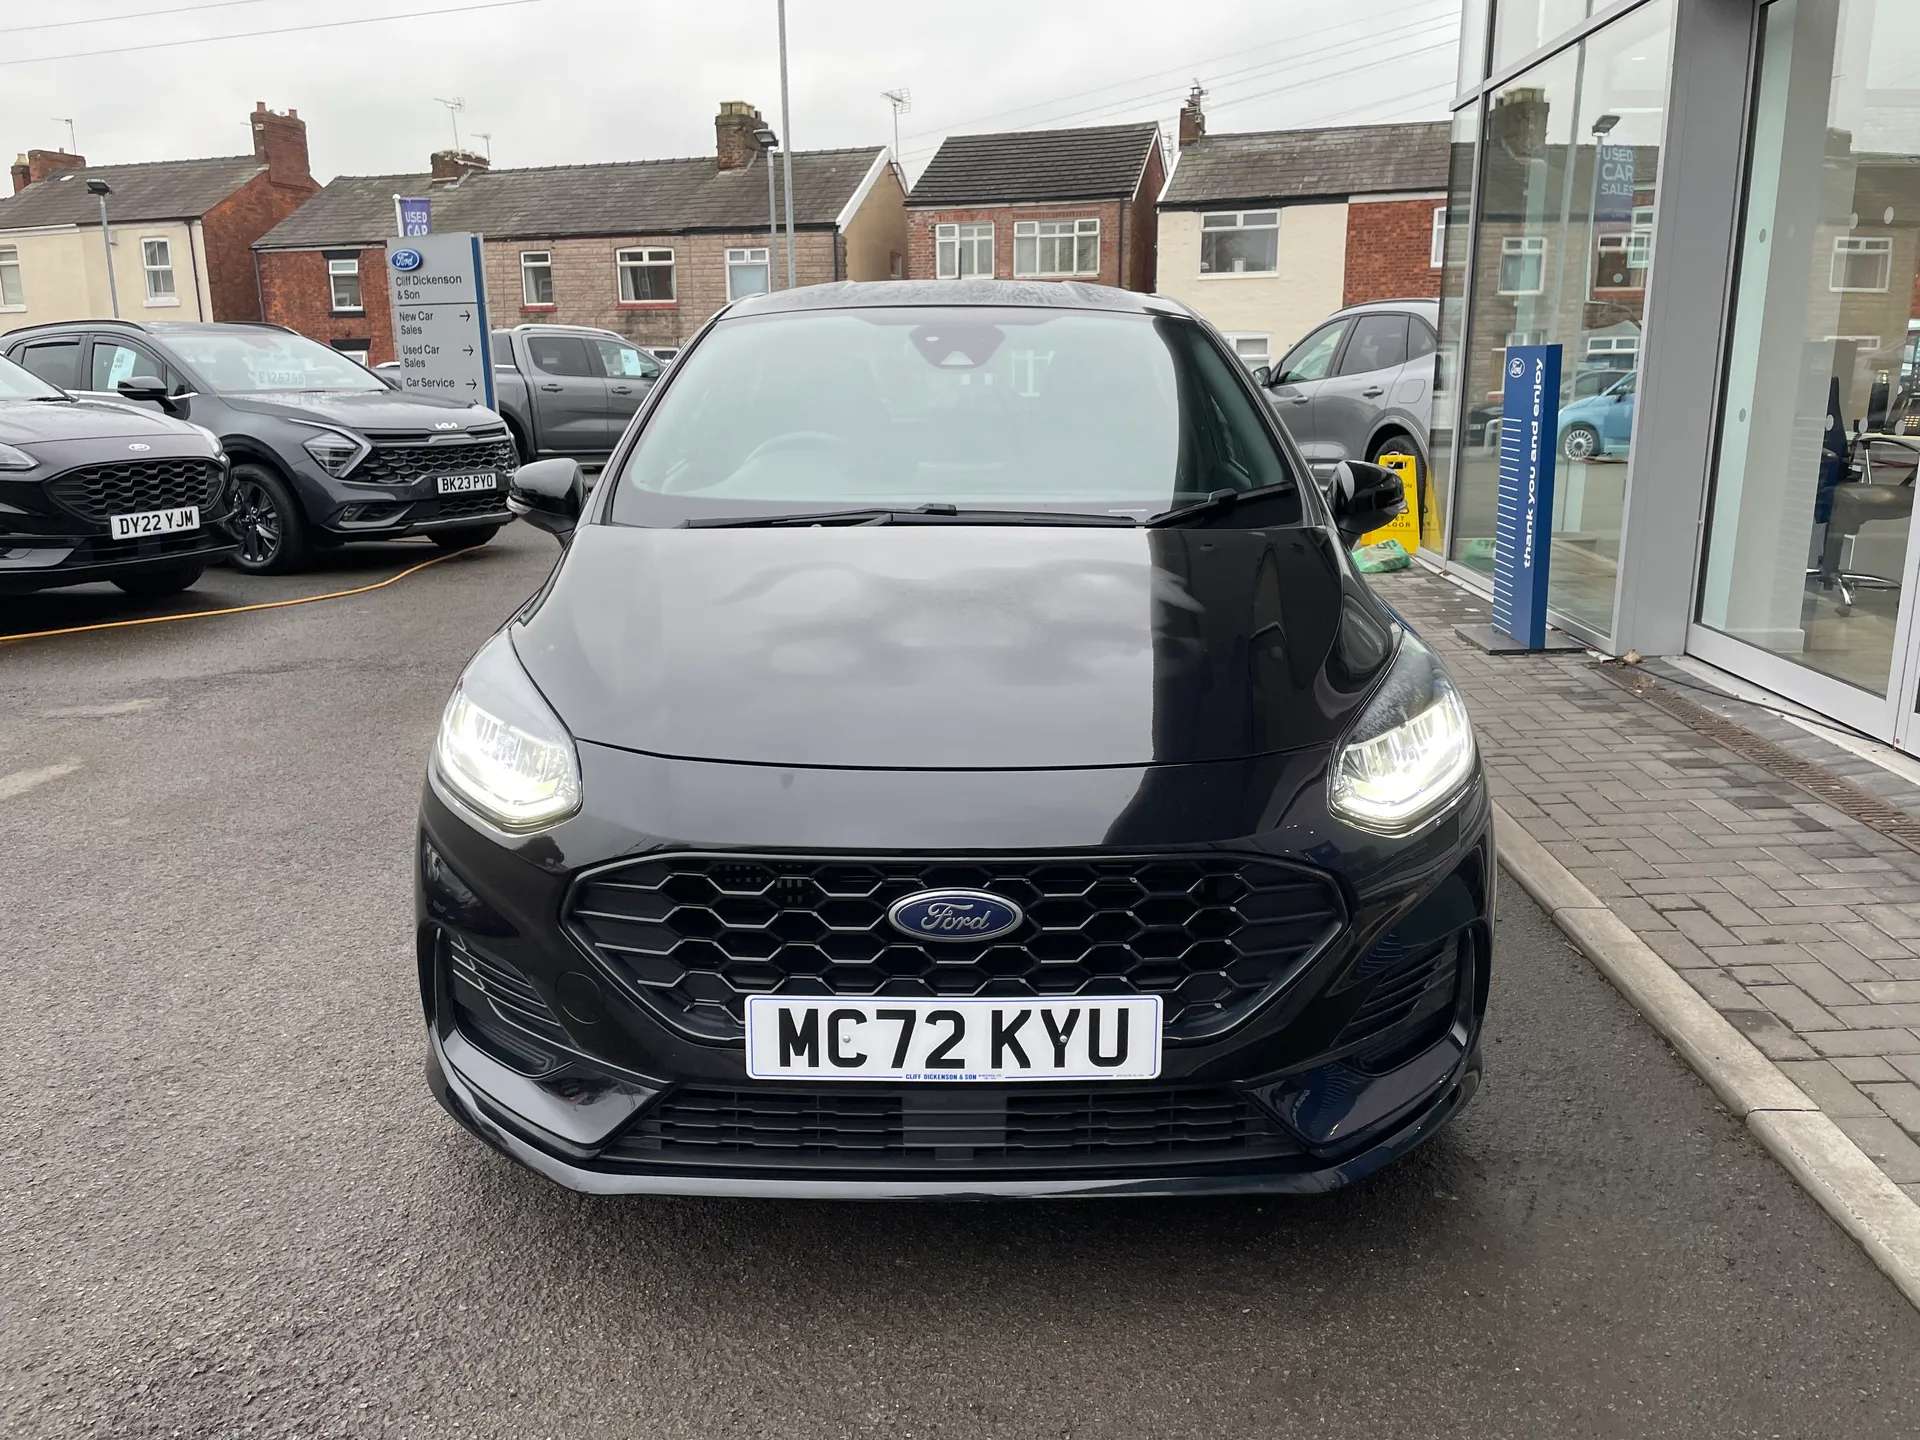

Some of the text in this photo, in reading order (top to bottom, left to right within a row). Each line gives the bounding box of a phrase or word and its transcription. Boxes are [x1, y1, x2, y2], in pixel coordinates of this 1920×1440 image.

[1602, 147, 1633, 161] USED
[1602, 163, 1634, 182] CAR
[405, 212, 427, 223] USED
[395, 275, 462, 286] Cliff Dickenson
[397, 290, 420, 299] & Son
[399, 311, 433, 321] New Car
[401, 325, 422, 335] Sales
[403, 345, 440, 354] Used Car
[404, 358, 425, 368] Sales
[406, 378, 455, 387] Car Service
[1524, 358, 1543, 568] thank you and enjoy
[442, 475, 493, 491] BK23 PYO
[119, 510, 194, 535] DY22 YJM
[778, 1008, 1129, 1069] MC72 KYU
